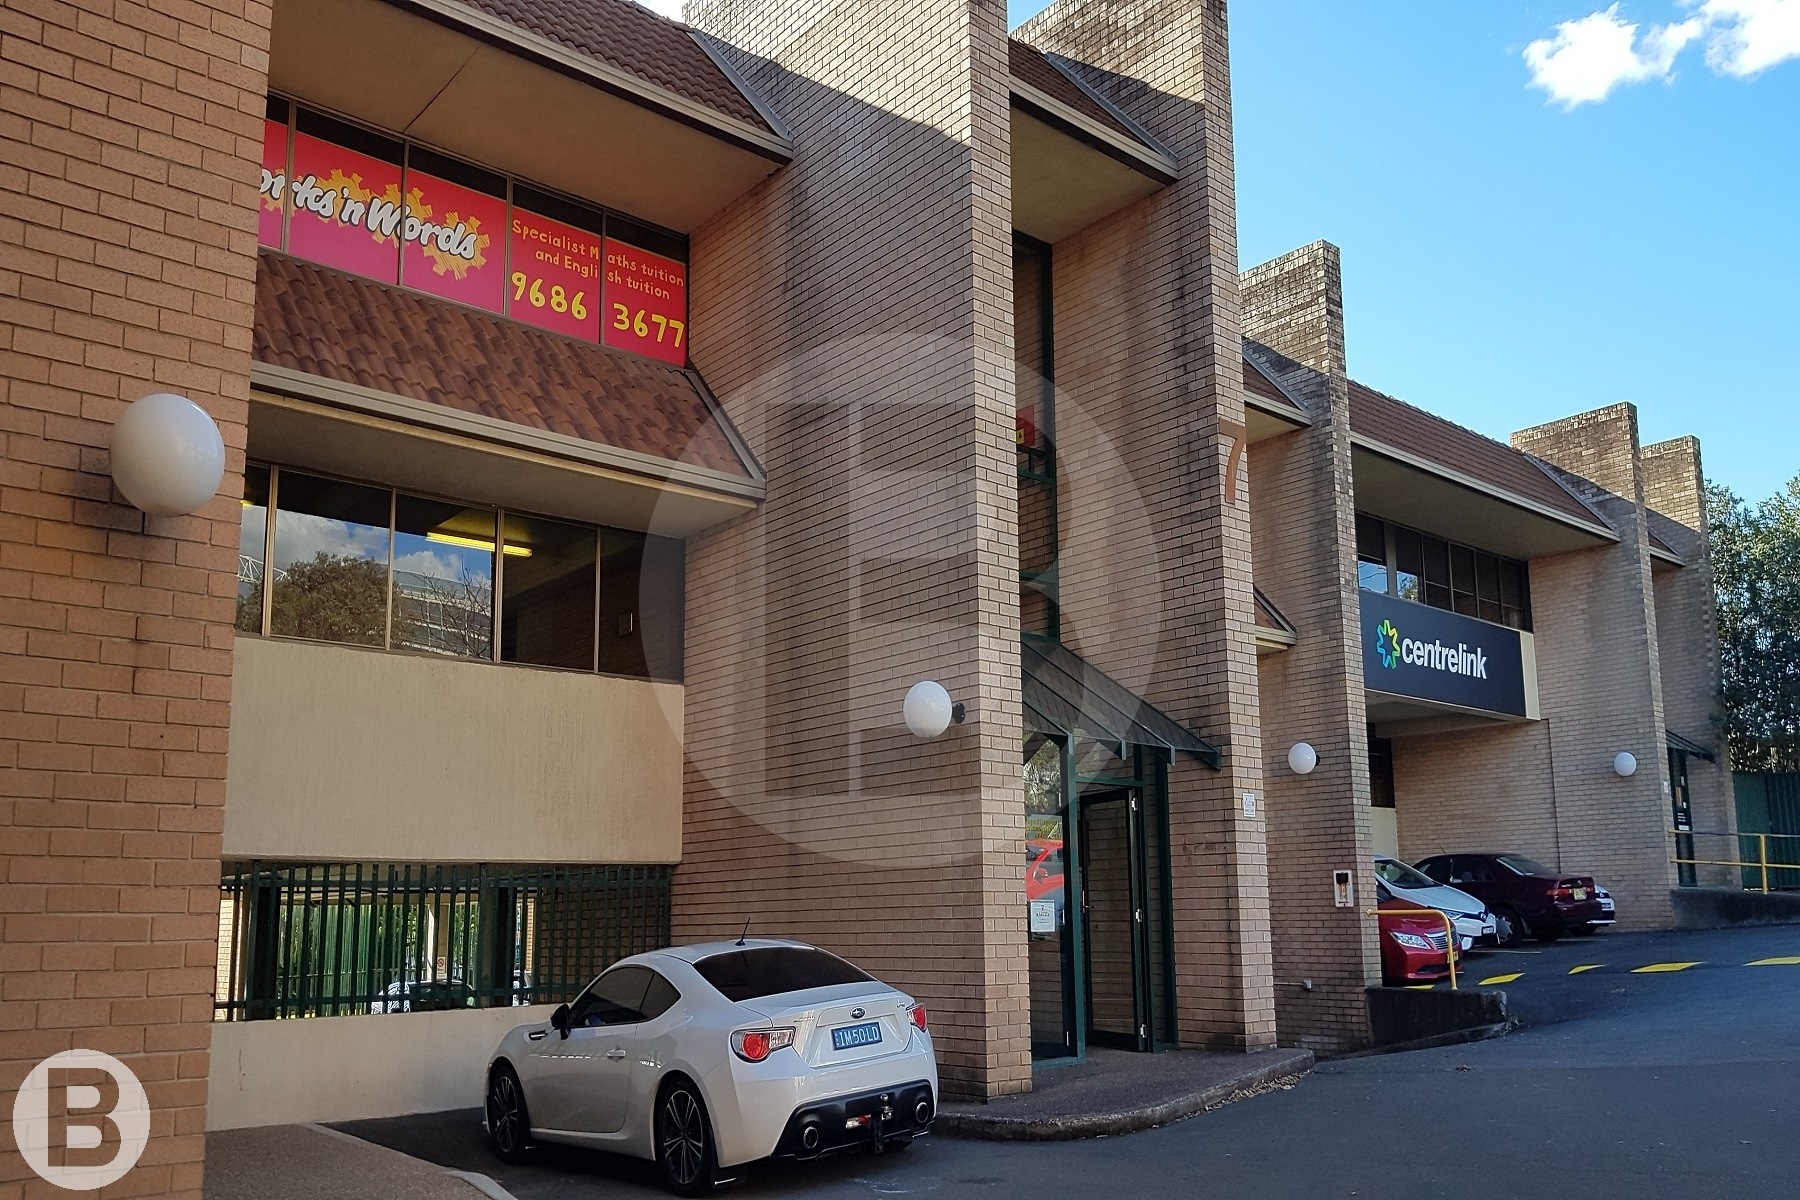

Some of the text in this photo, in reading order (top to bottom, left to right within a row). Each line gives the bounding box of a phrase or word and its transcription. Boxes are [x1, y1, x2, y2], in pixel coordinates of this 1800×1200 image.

[366, 196, 477, 260] Words
[512, 219, 586, 256] Specialist
[640, 263, 684, 287] tuition
[535, 249, 560, 266] and
[626, 276, 670, 300] tuition
[511, 271, 685, 348] 9686 3677
[1218, 417, 1247, 505] 7
[1401, 637, 1488, 680] centrelink
